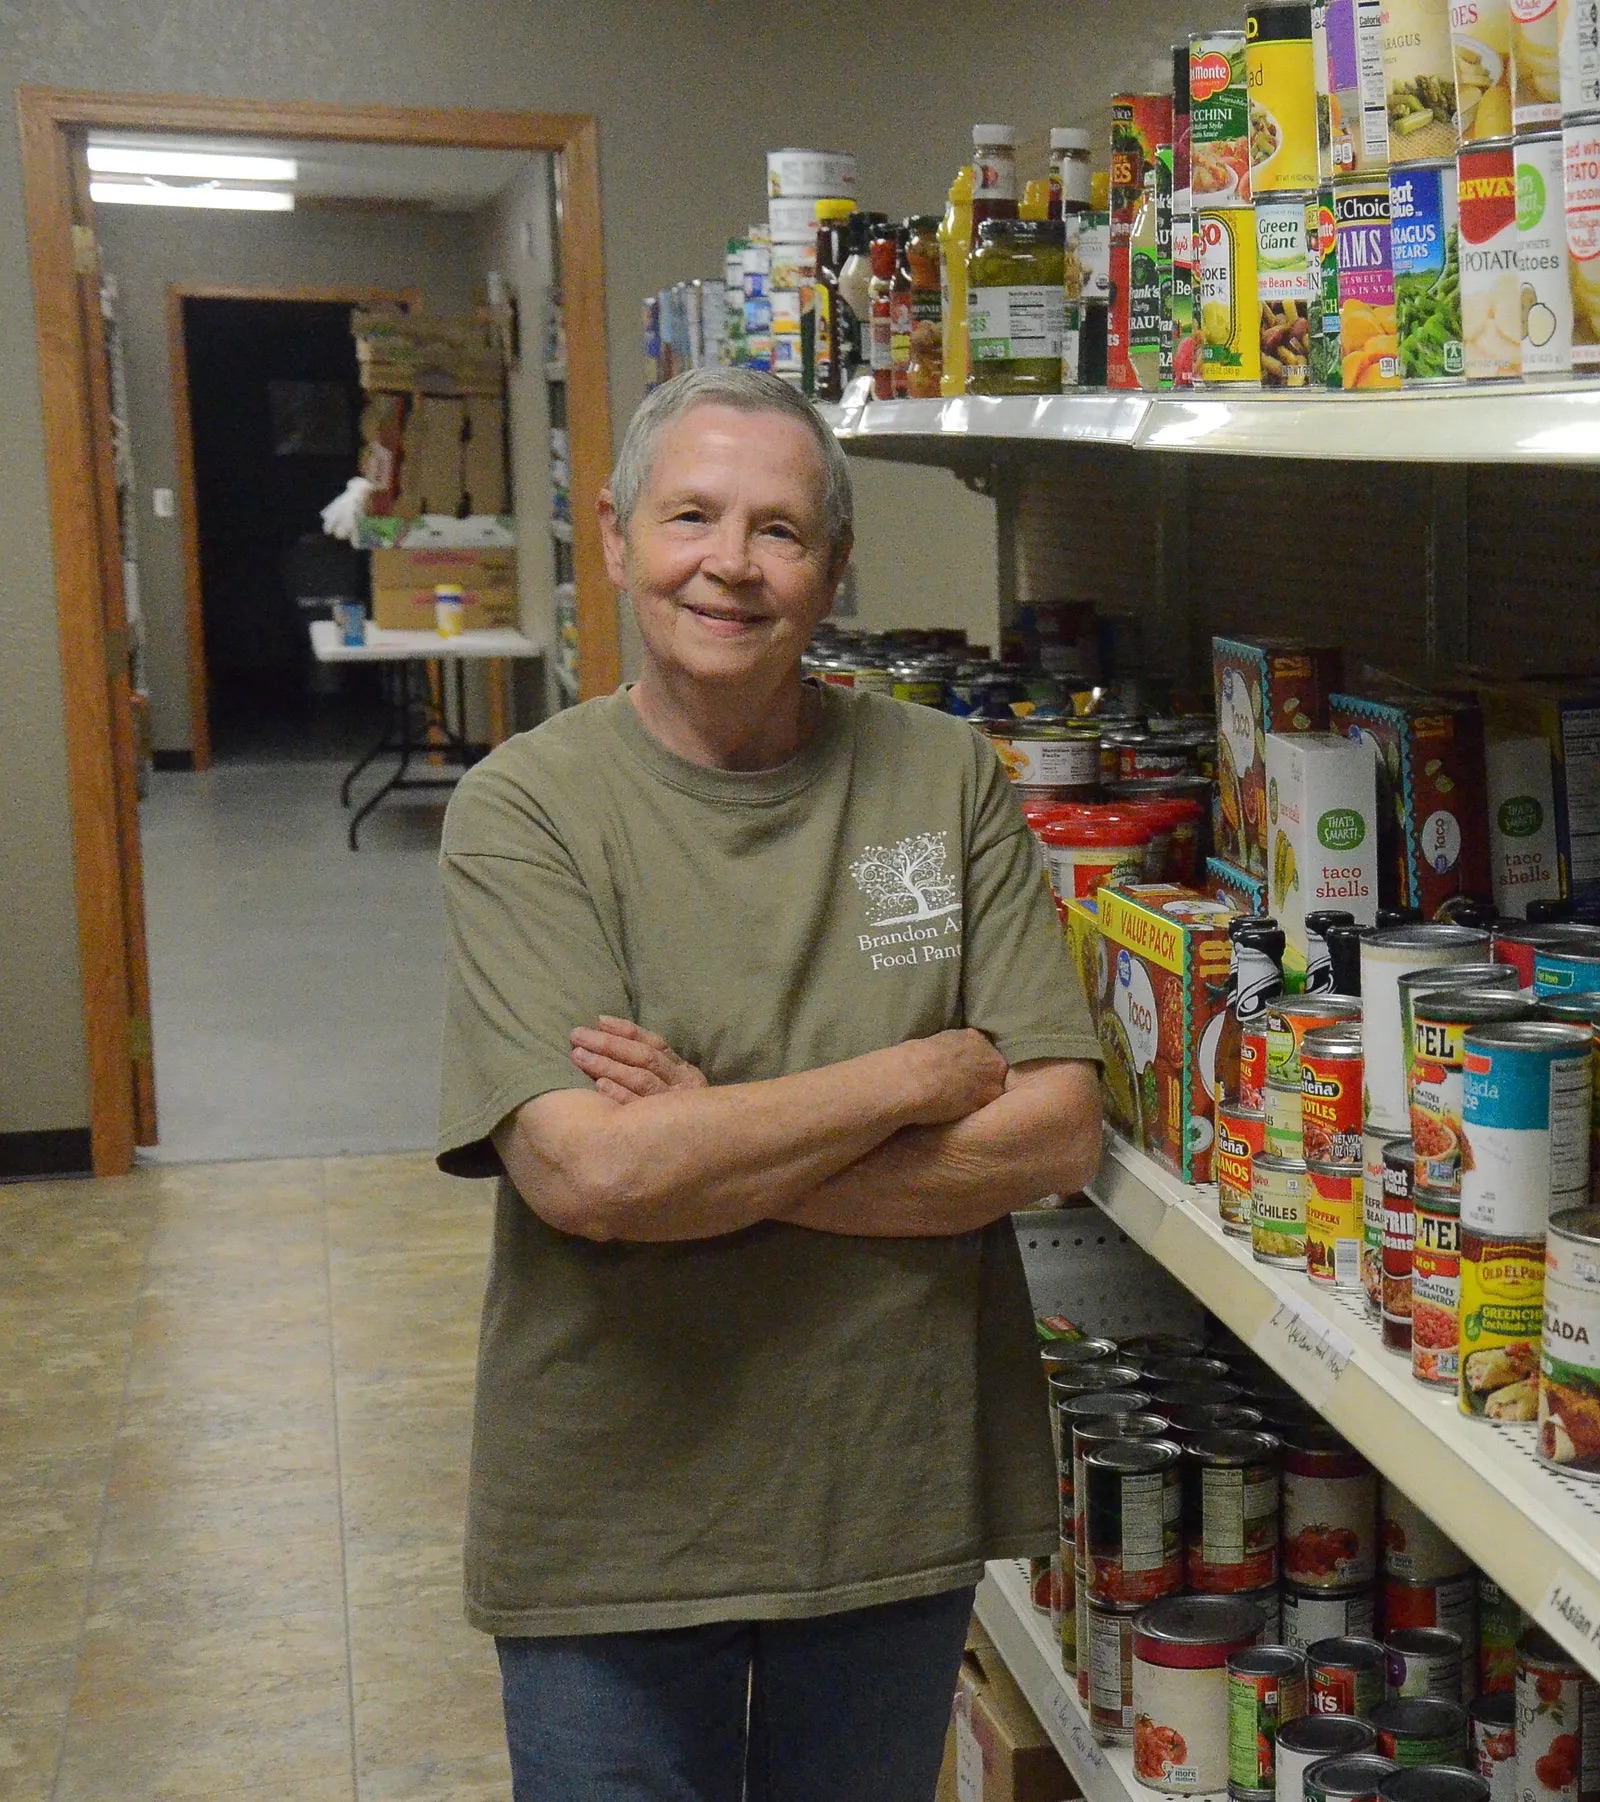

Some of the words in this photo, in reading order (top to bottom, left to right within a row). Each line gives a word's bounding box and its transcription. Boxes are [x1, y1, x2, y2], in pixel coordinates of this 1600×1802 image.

[1193, 108, 1233, 122] CCHINI
[1259, 218, 1299, 235] Green
[1260, 234, 1297, 250] Giant
[1268, 277, 1292, 289] Bean
[1326, 815, 1355, 829] THAT'S
[1435, 817, 1447, 851] Taco
[1505, 852, 1543, 865] taco
[1322, 865, 1362, 878] taco
[1501, 868, 1550, 886] shells
[1316, 883, 1369, 899] shells
[858, 925, 939, 951] Brandon
[1121, 908, 1148, 947] VALUE
[1148, 924, 1176, 961] PACK
[870, 948, 917, 971] Food
[1126, 990, 1152, 1036] Taco
[1260, 1203, 1298, 1220] CHILES
[1415, 1255, 1437, 1271] Hot
[1482, 1306, 1521, 1319] GREEN
[1550, 1587, 1592, 1637] 1-Asian
[1175, 1770, 1197, 1778] more
